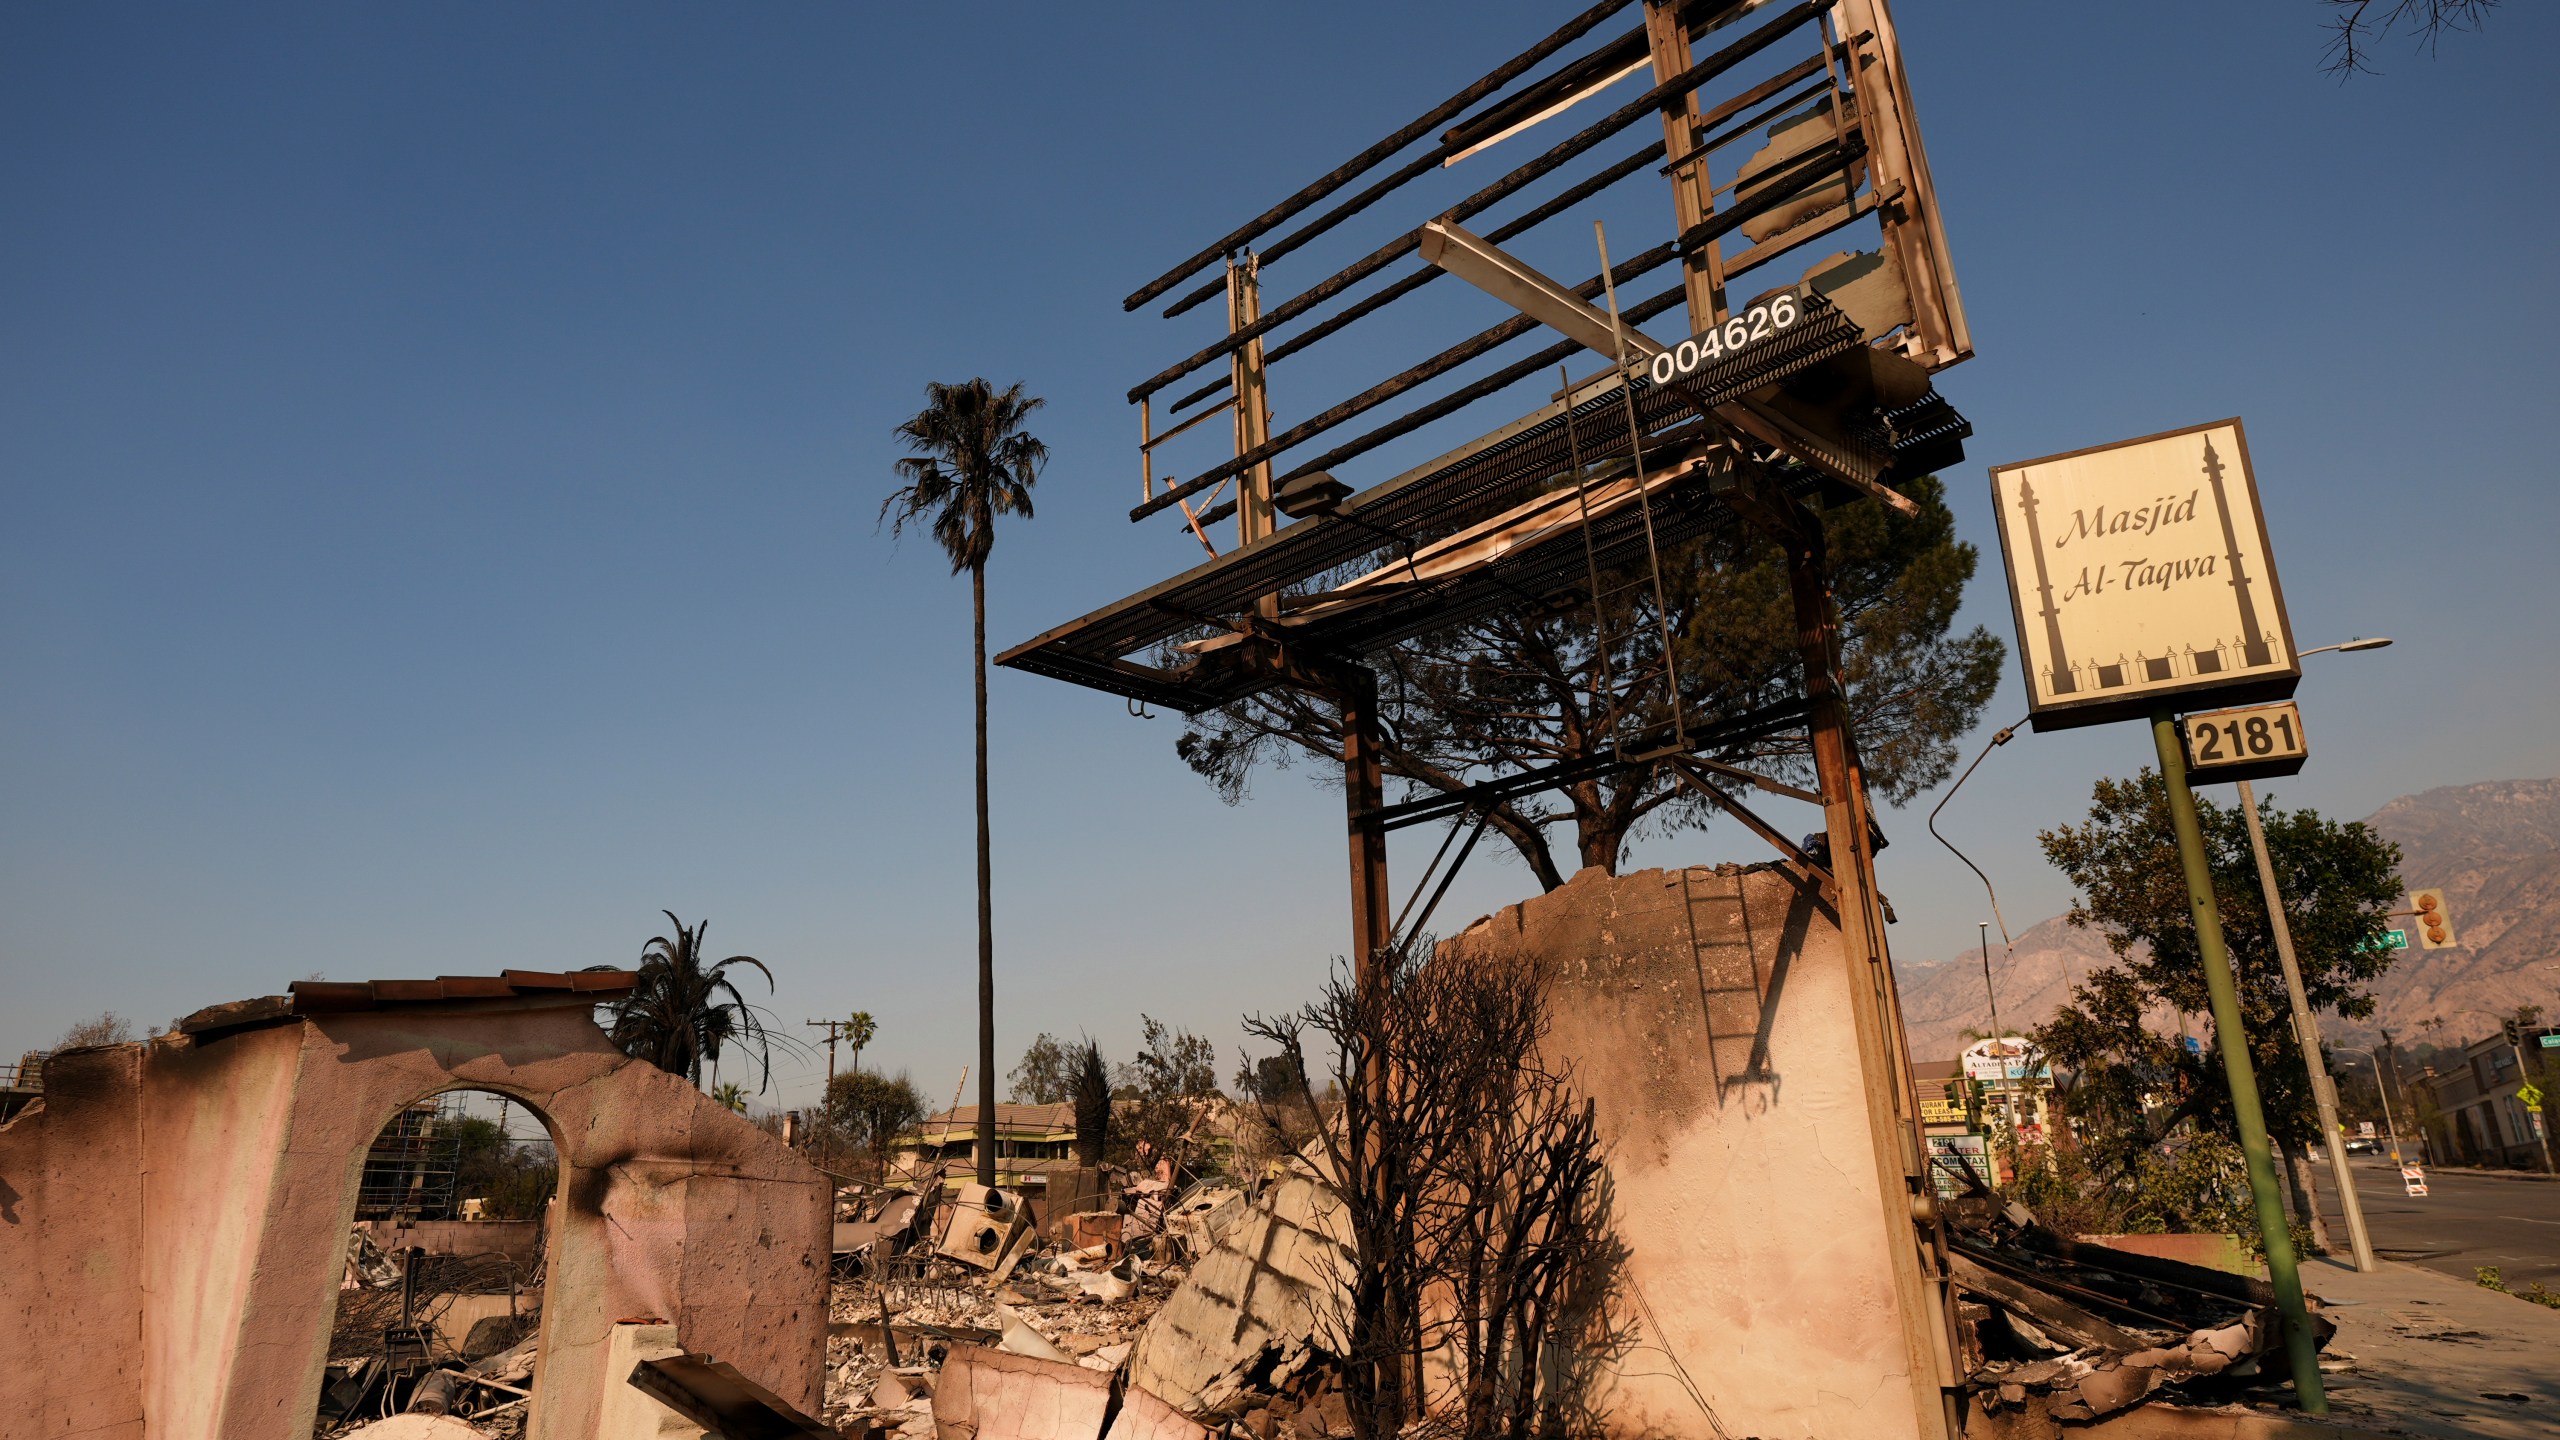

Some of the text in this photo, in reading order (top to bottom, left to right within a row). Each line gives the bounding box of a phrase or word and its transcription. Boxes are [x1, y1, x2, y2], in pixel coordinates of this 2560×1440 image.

[1652, 295, 1796, 384] 004626
[2055, 489, 2199, 548] Masjid
[2063, 554, 2216, 603] Al-Taqwa
[2195, 713, 2297, 761] 2181
[1937, 1147, 1979, 1155] CETER
